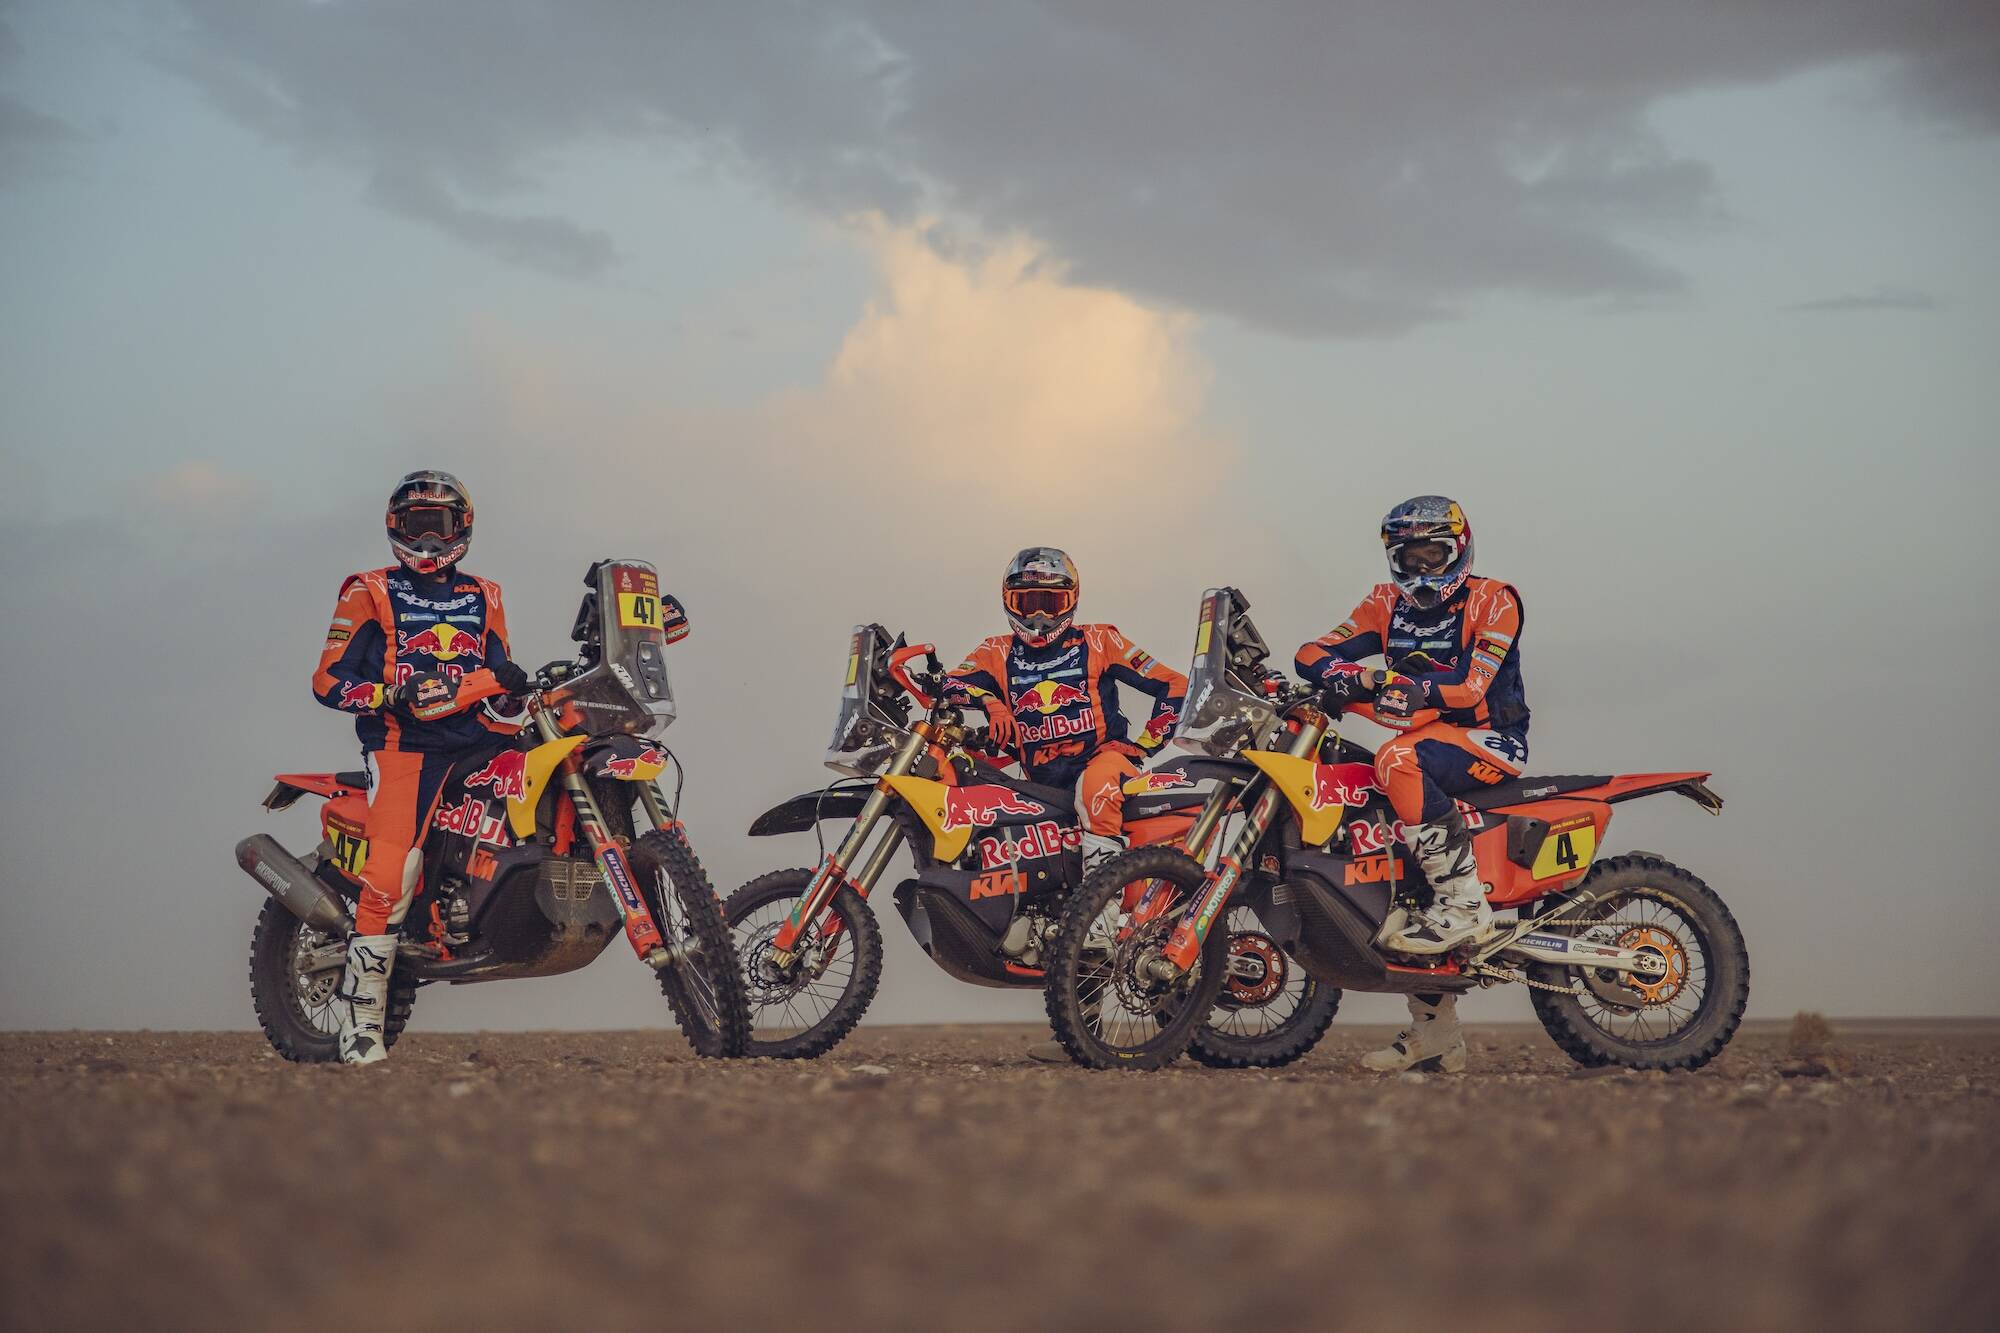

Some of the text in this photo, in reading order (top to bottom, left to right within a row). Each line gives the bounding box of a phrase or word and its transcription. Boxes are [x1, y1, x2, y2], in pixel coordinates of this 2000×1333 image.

[408, 490, 446, 499] Red Bull
[397, 592, 476, 611] alpinestars
[634, 596, 655, 625] 47
[417, 685, 449, 701] Red Bull
[424, 702, 456, 716] MOTOREX
[1018, 707, 1096, 743] Red Bull
[1467, 761, 1504, 785] KTM
[433, 793, 472, 835] ed
[336, 832, 361, 873] 47
[980, 825, 1043, 870] Red
[1557, 832, 1579, 870] 4
[465, 848, 499, 882] KTM
[606, 853, 635, 902] MICHELIN
[1344, 855, 1404, 886] KTM
[969, 869, 1027, 900] KTM
[1203, 869, 1236, 918] MOTOREX
[1519, 938, 1563, 949] MICHELIN
